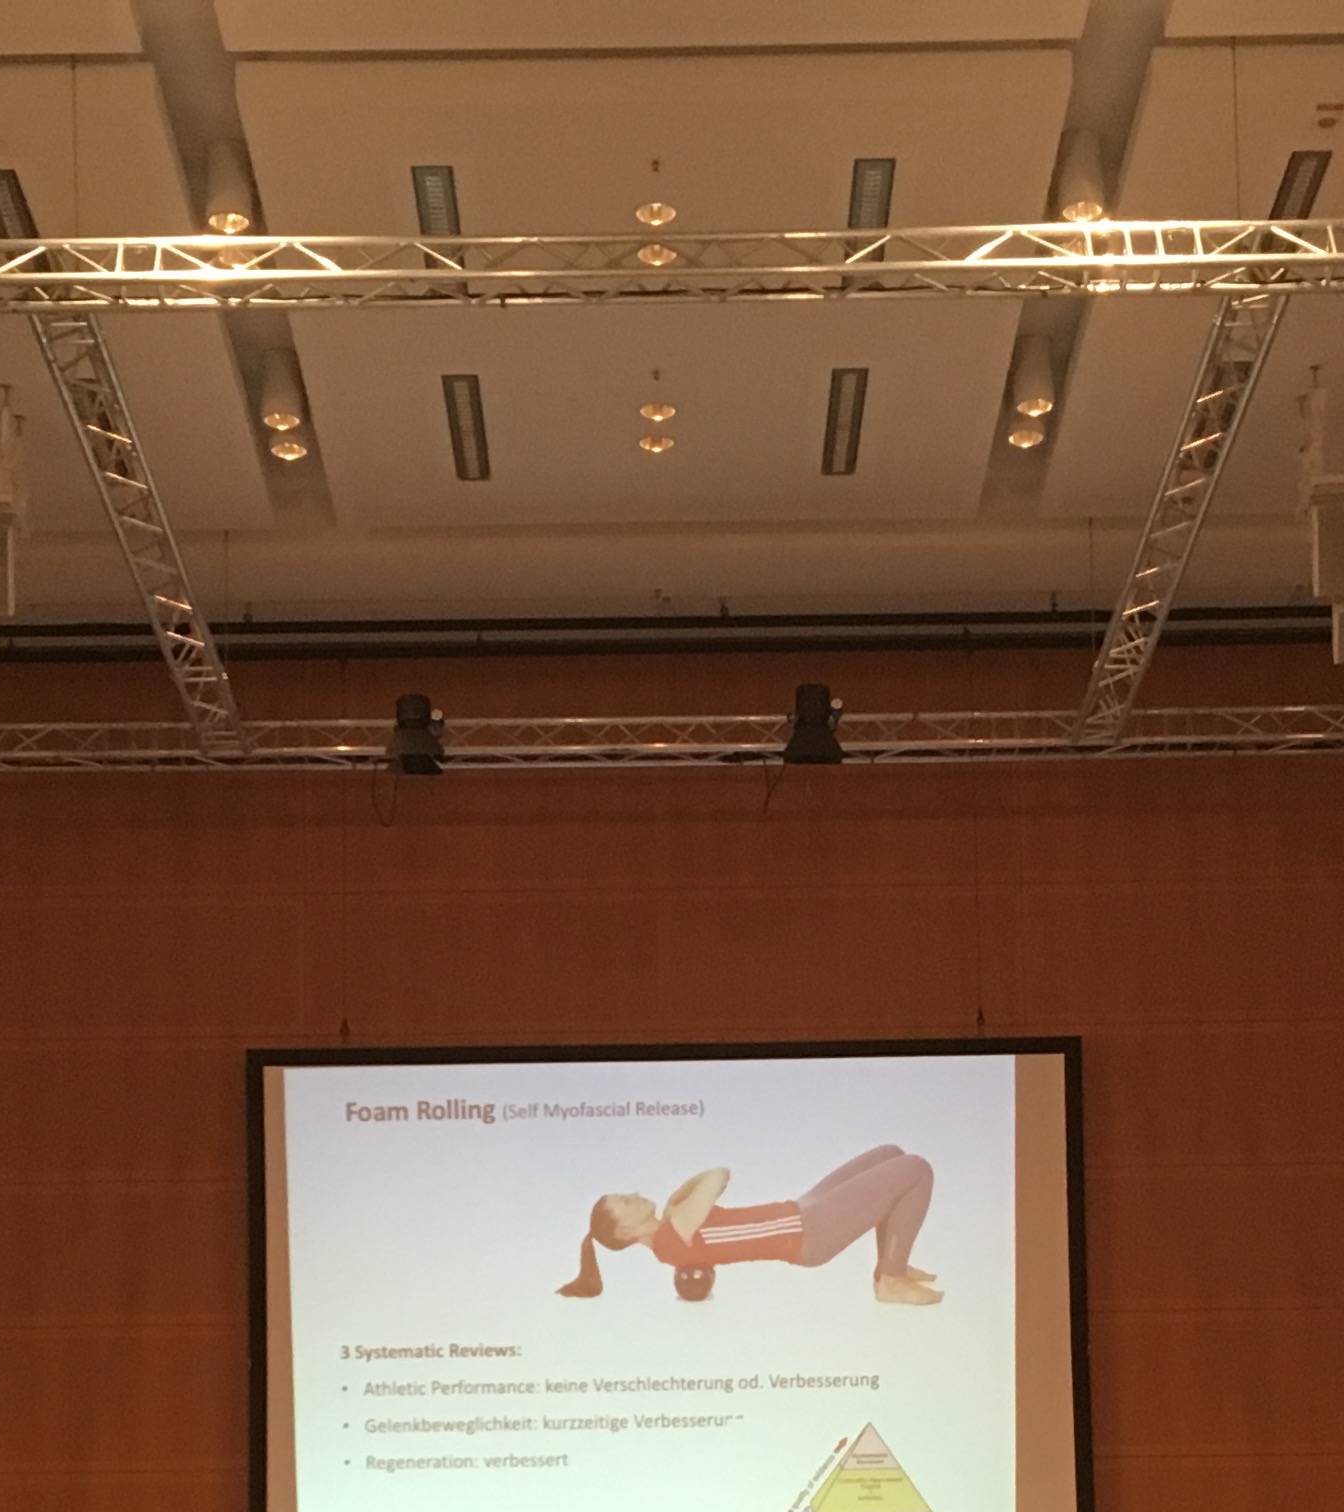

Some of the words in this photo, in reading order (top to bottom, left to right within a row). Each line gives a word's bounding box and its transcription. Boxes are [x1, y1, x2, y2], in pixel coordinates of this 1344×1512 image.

[345, 1102, 408, 1122] Foam
[416, 1099, 496, 1124] Rolling
[502, 1102, 539, 1120] (Self
[543, 1101, 630, 1120] Myofascial
[635, 1099, 705, 1118] Release)
[340, 1345, 351, 1360] 3
[354, 1344, 444, 1362] Systematic
[449, 1343, 522, 1358] Reviews:
[363, 1381, 426, 1396] Athletic
[431, 1380, 540, 1395] Performance:
[545, 1379, 588, 1393] keine
[593, 1376, 734, 1393] Verschlechterung
[738, 1375, 764, 1390] od.
[769, 1373, 880, 1390] Verbesserung
[364, 1416, 538, 1435] Gelenkbeweglichkeit:
[543, 1414, 628, 1433] kurzzeitige
[366, 1454, 479, 1473] Regeneration:
[483, 1453, 568, 1469] verbessert
